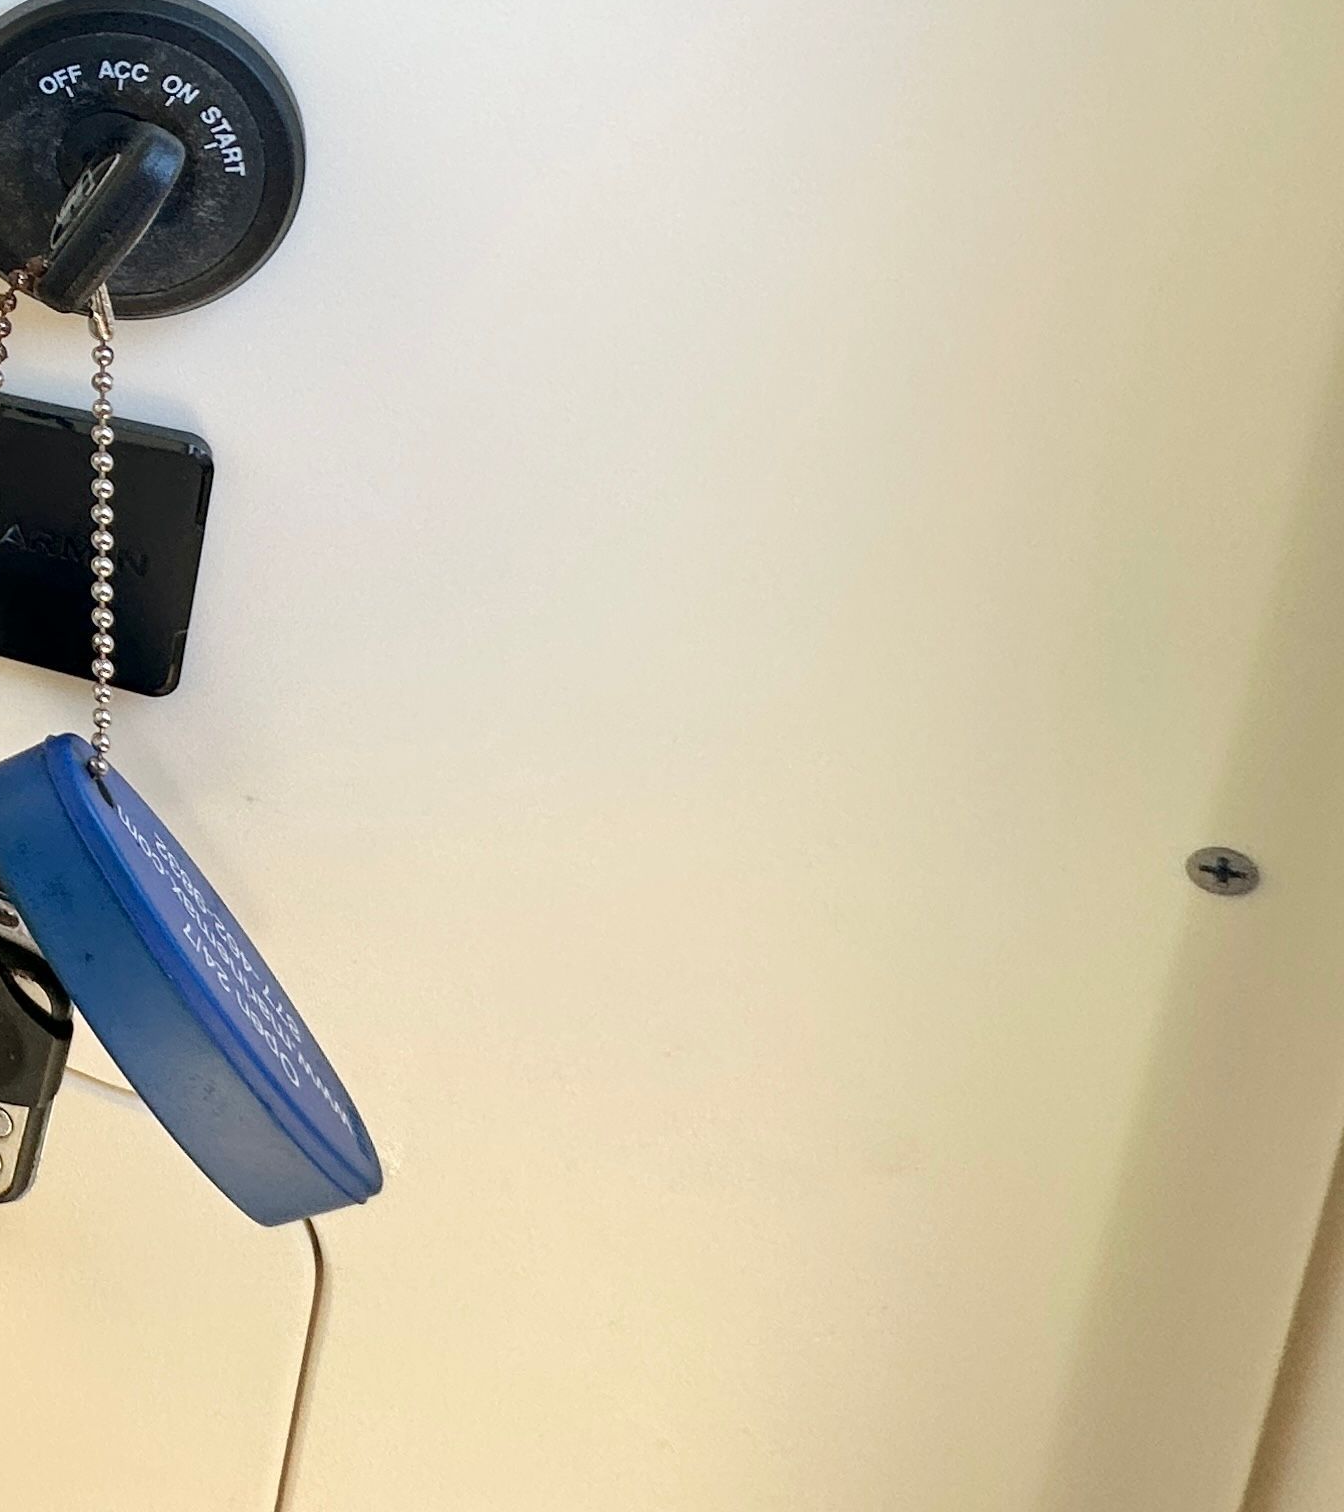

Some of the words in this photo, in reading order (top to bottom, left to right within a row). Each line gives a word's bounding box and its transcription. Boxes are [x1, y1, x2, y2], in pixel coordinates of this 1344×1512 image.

[38, 64, 82, 94] OFF
[98, 60, 149, 82] ACC
[162, 75, 200, 104] ON
[199, 106, 246, 177] START
[183, 923, 231, 993] 24/7
[235, 990, 300, 1088] Open
